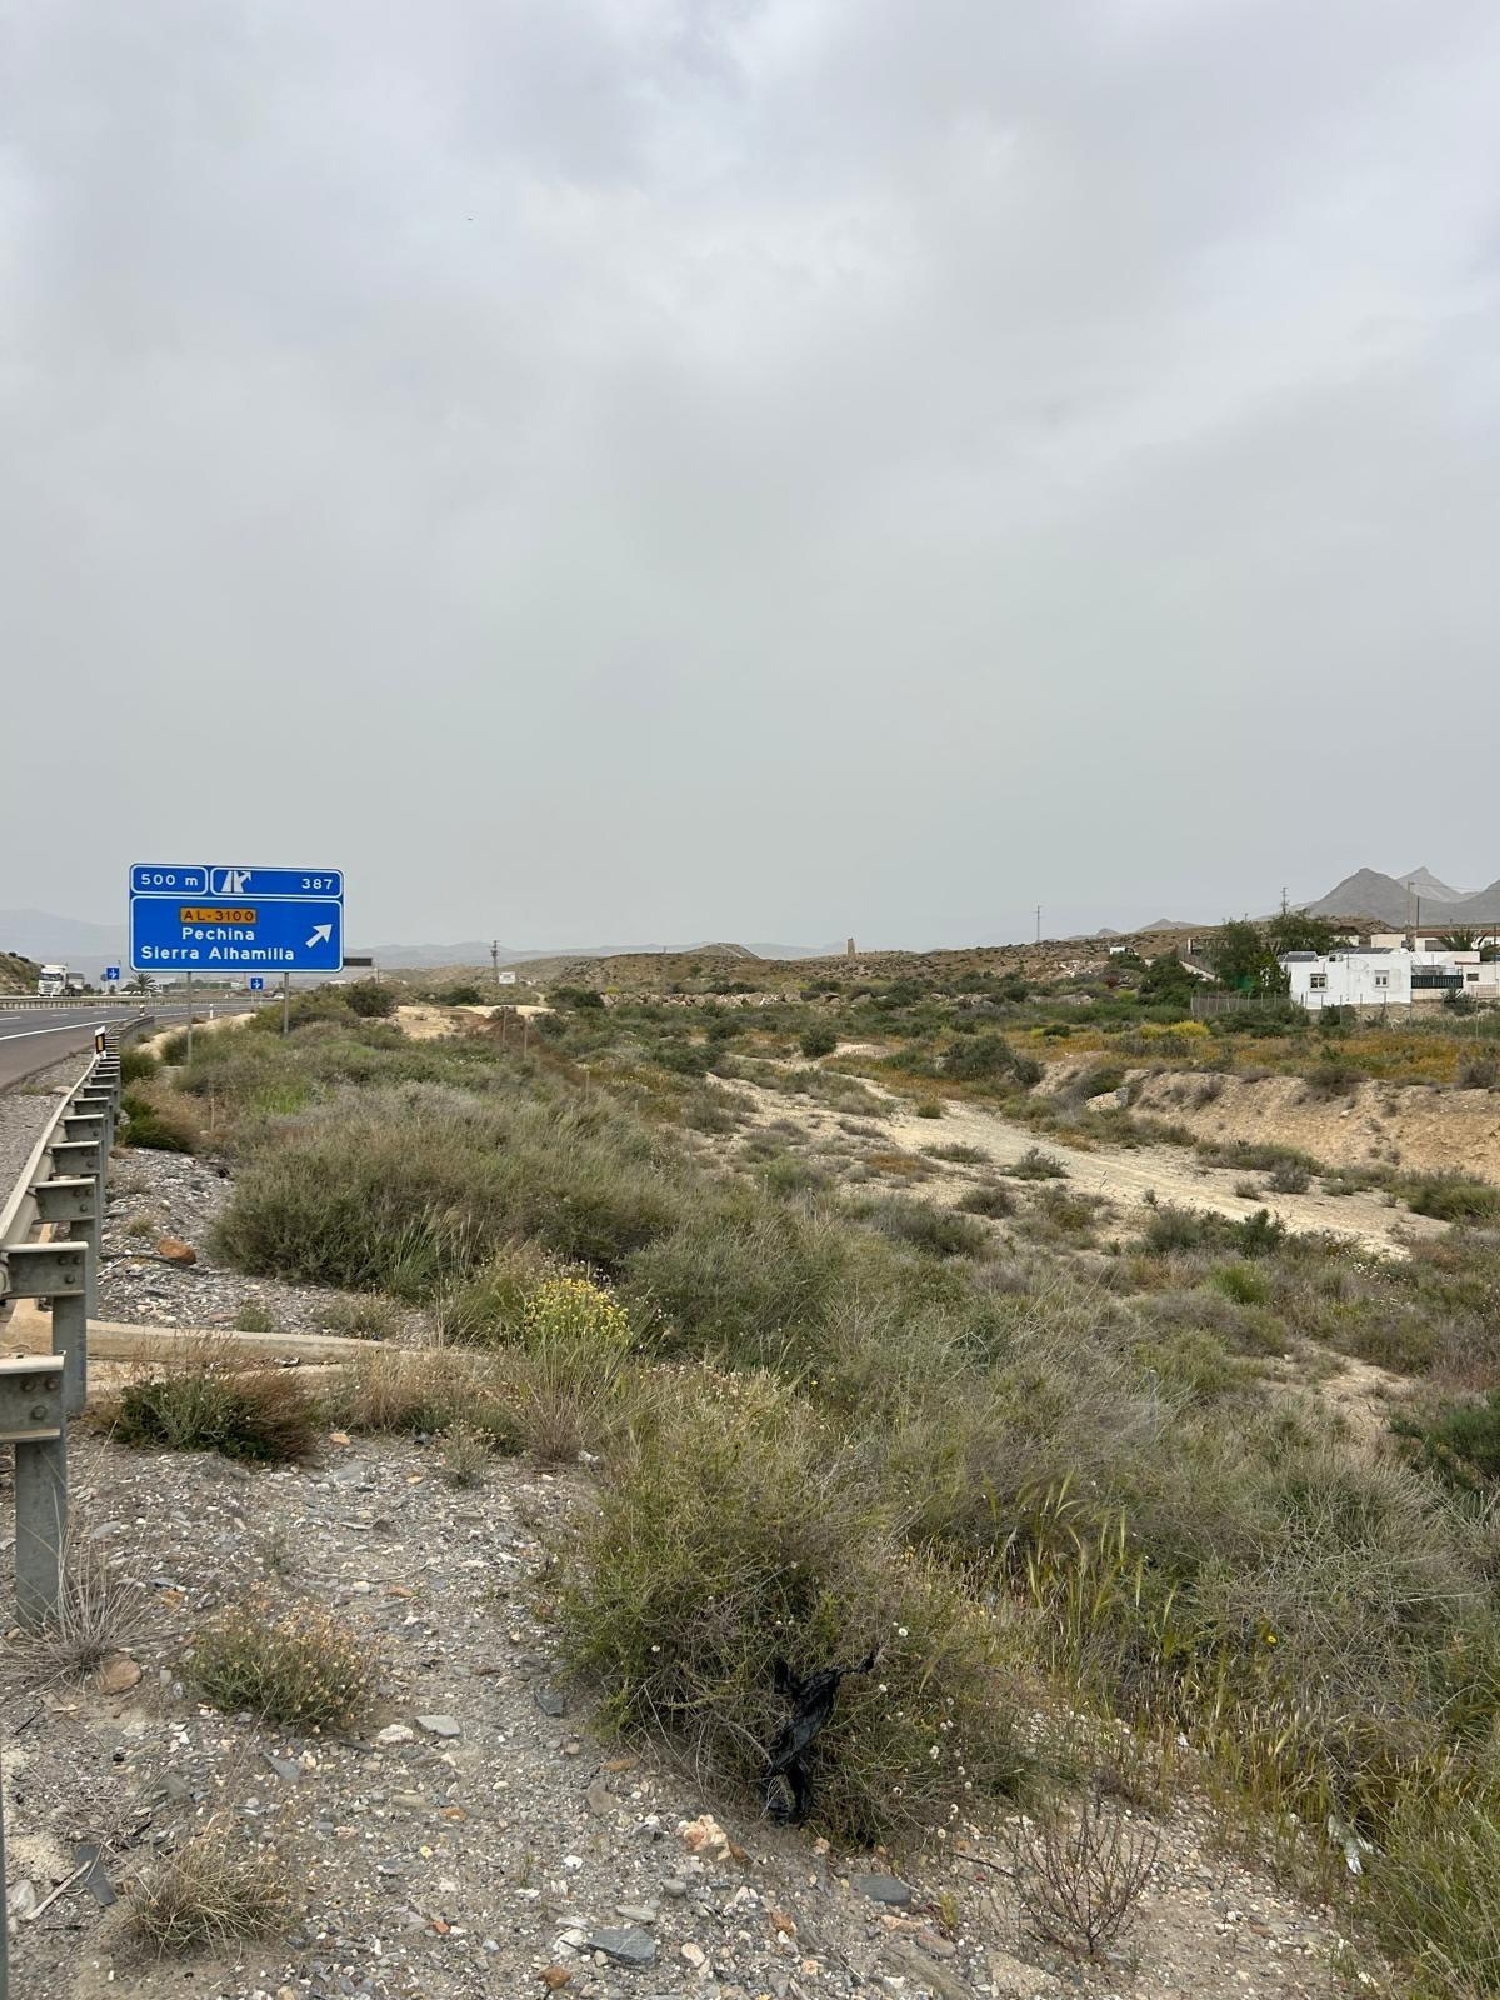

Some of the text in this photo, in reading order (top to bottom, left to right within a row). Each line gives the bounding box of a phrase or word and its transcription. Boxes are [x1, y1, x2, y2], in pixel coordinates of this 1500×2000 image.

[140, 873, 199, 886] 500 m
[301, 878, 334, 890] 387
[183, 910, 255, 921] AL-3100
[182, 927, 255, 941] Pechina
[140, 945, 295, 961] Sierra Alhamilla
